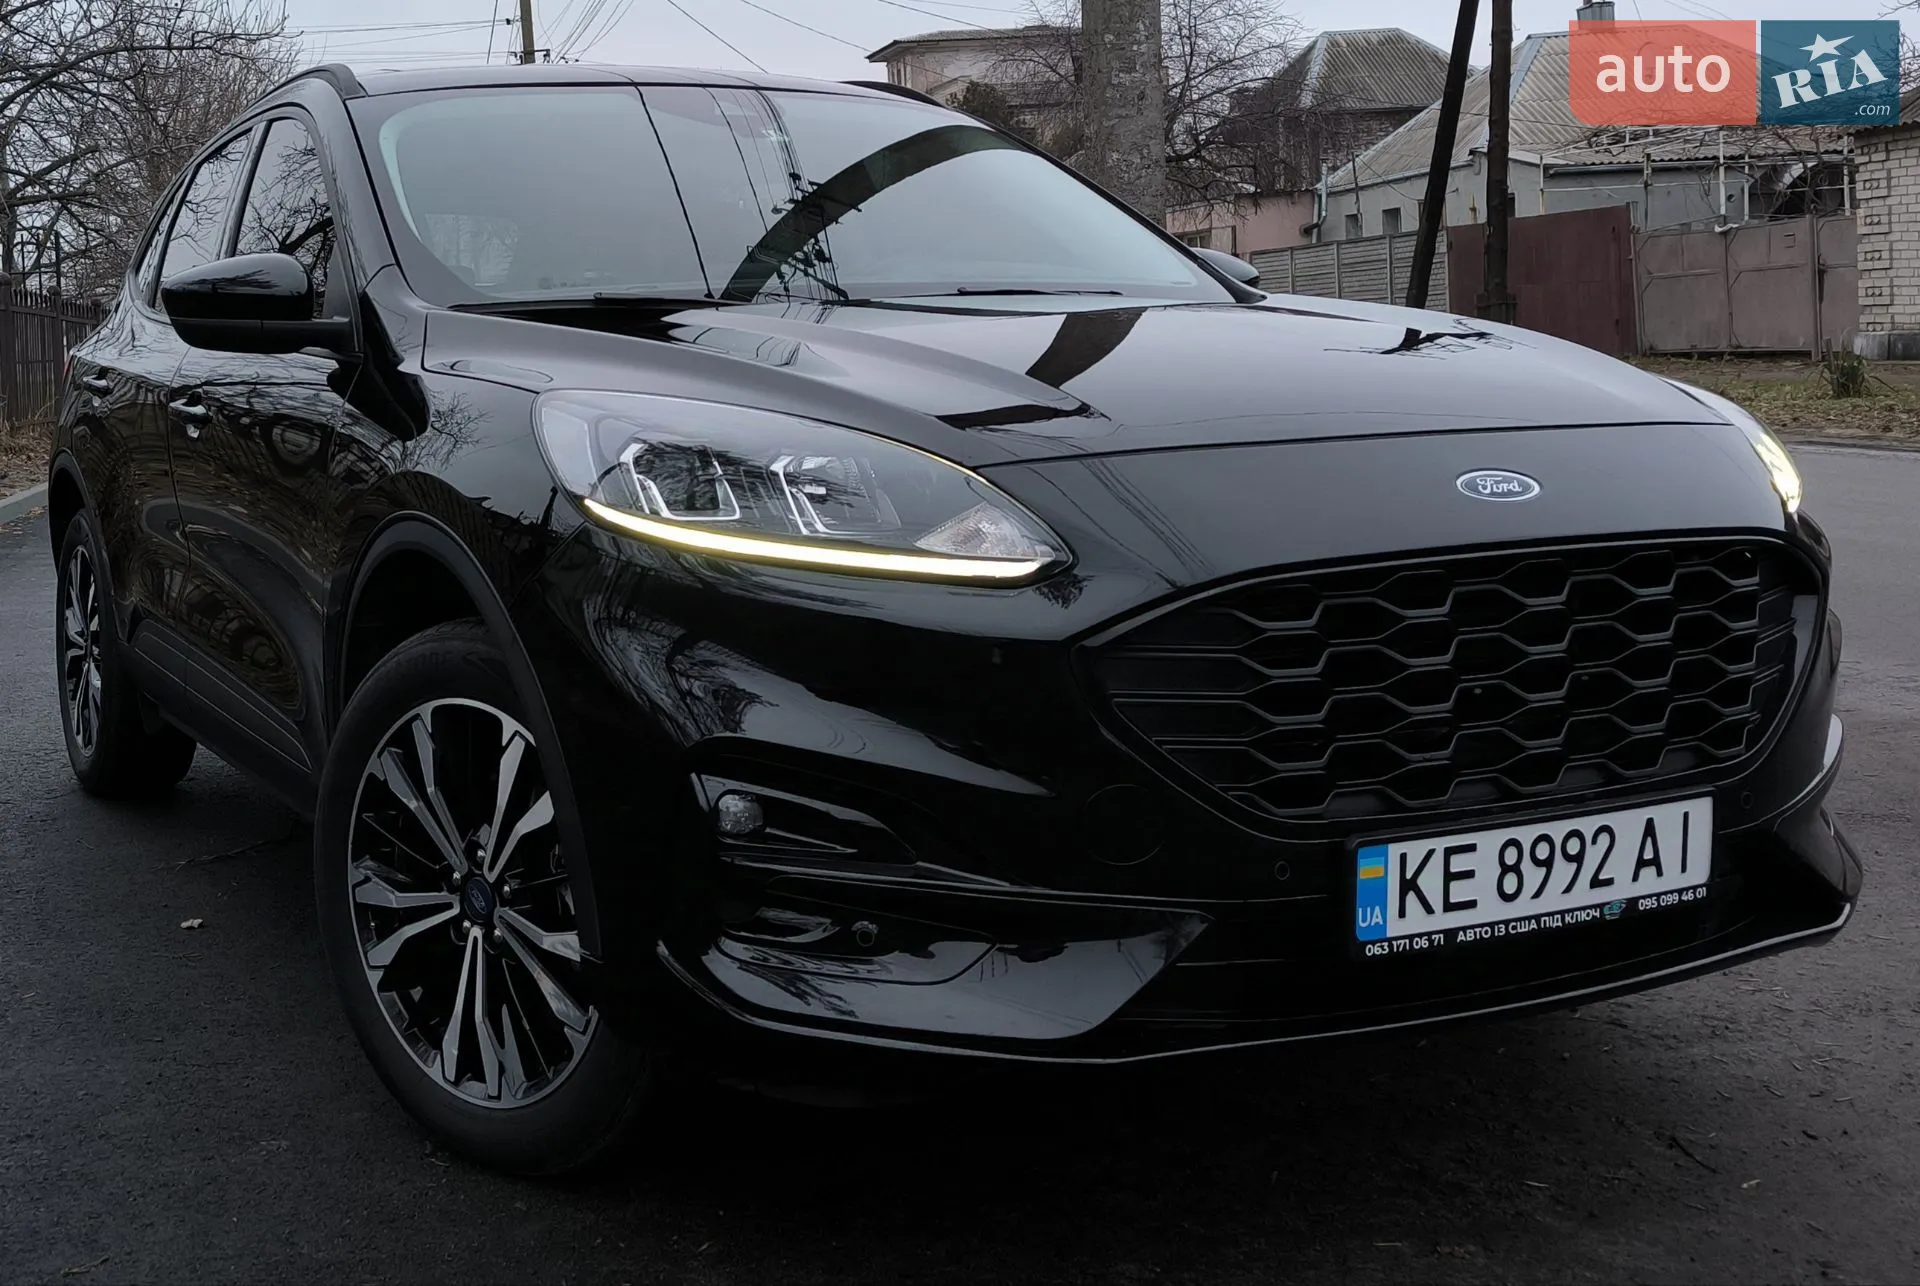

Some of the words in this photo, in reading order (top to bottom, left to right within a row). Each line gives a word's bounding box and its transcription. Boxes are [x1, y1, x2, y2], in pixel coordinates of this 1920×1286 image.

[1476, 477, 1522, 494] Ford
[1398, 843, 1478, 919] KE
[1497, 824, 1616, 902] 8992
[1632, 811, 1689, 882] AI
[1359, 907, 1383, 927] UA
[1365, 942, 1389, 956] 063
[1392, 939, 1409, 952] 171
[1413, 936, 1429, 949] 06
[1432, 934, 1444, 946] 71
[1457, 927, 1491, 943] АВТО
[1495, 924, 1506, 936] ІЗ
[1509, 918, 1538, 934] США
[1541, 914, 1562, 928] ПІД
[1565, 908, 1600, 924] КЛЮЧ
[1638, 897, 1659, 910] 095
[1661, 892, 1678, 906] 099
[1681, 890, 1694, 901] 46
[1697, 887, 1706, 899] 01
